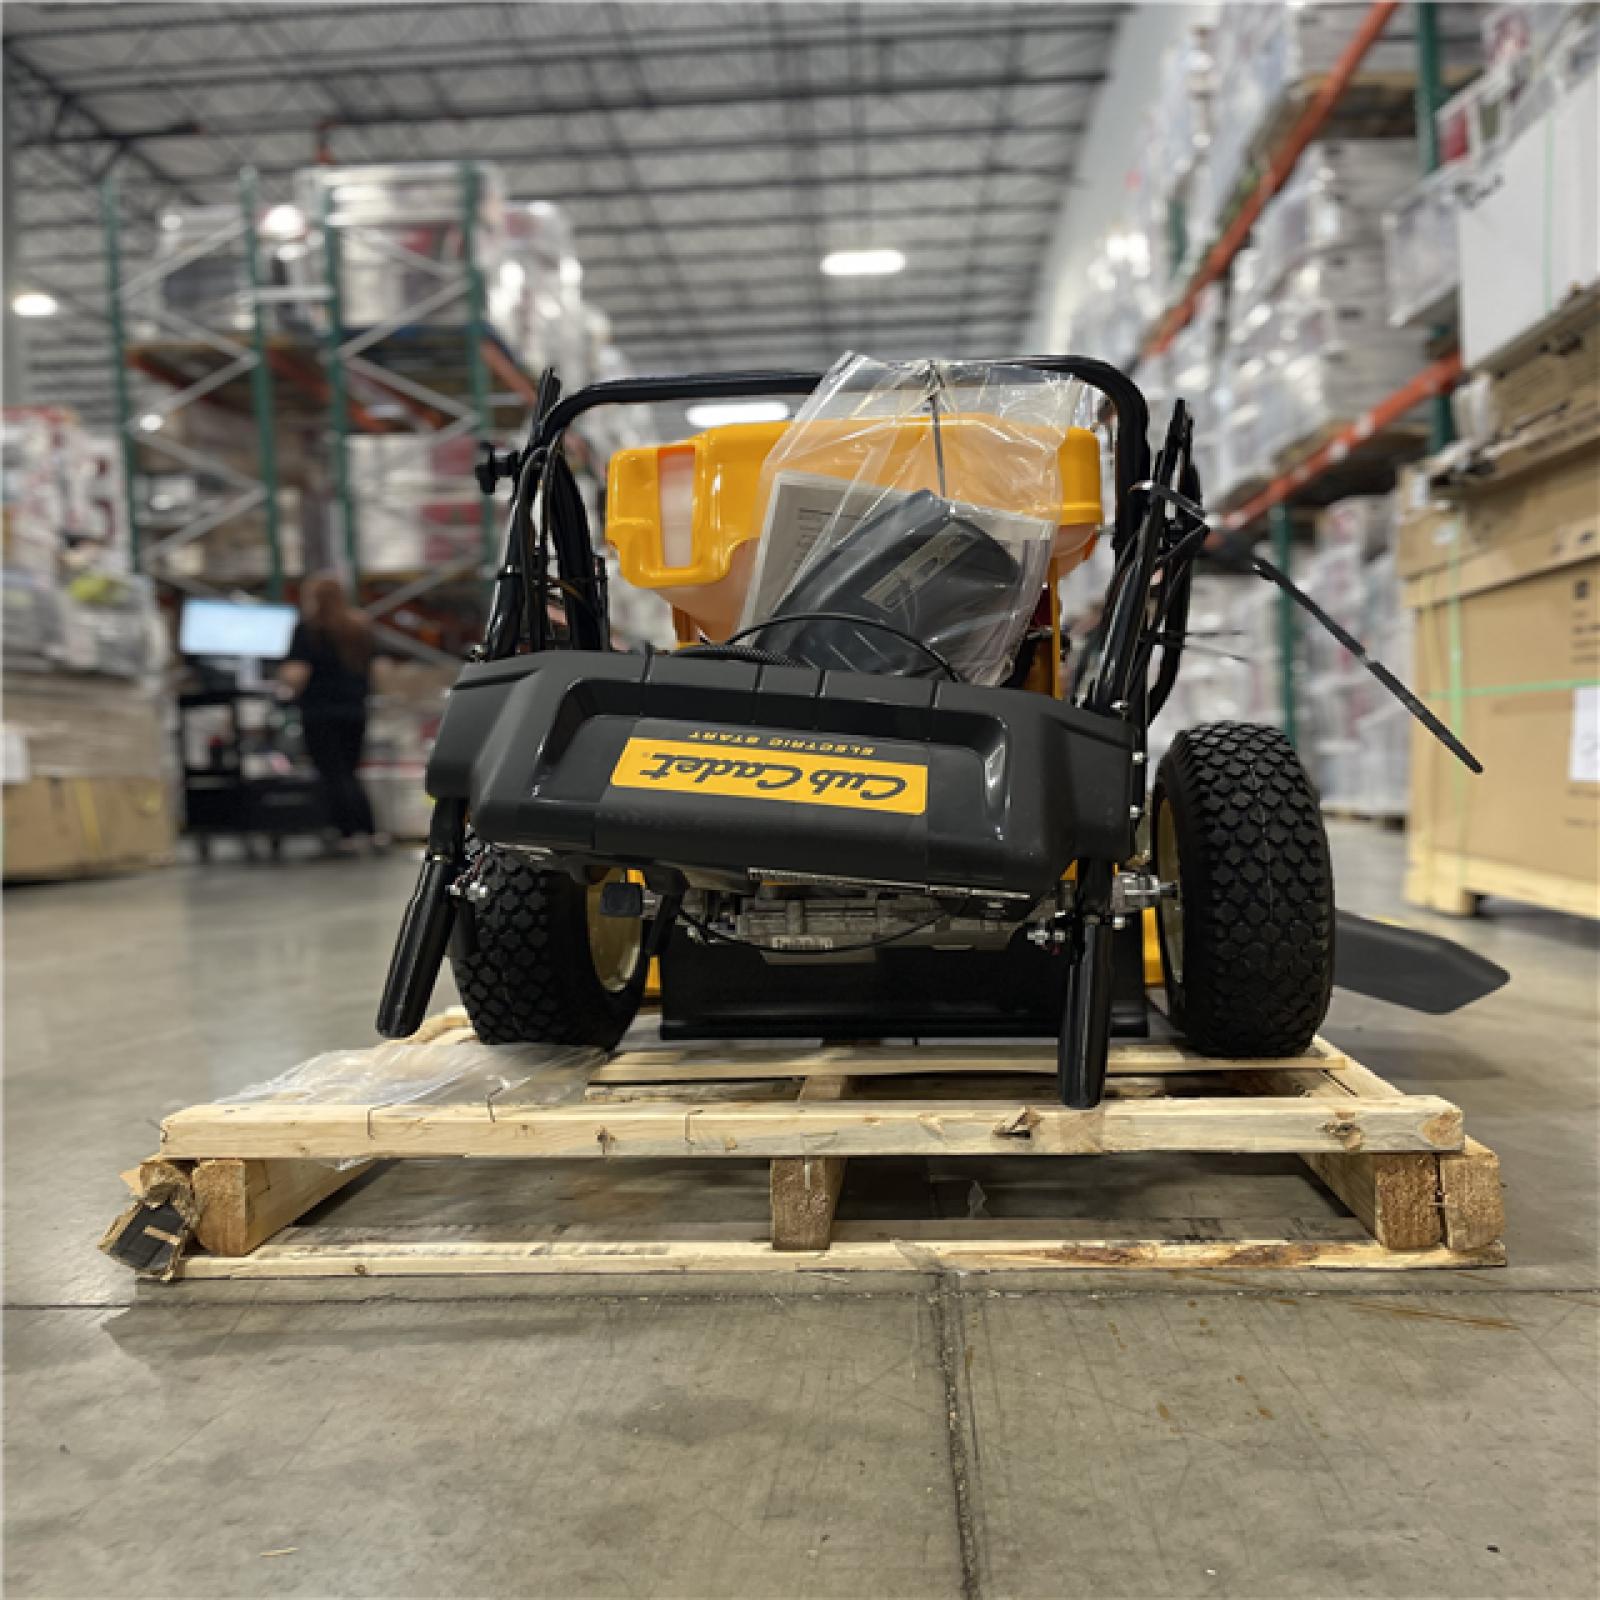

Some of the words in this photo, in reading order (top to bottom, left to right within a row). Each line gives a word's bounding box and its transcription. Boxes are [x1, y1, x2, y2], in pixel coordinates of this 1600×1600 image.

[688, 730, 760, 744] START
[768, 736, 875, 756] ELECTRIC
[639, 752, 804, 790] Cadet
[809, 768, 907, 801] Cub
